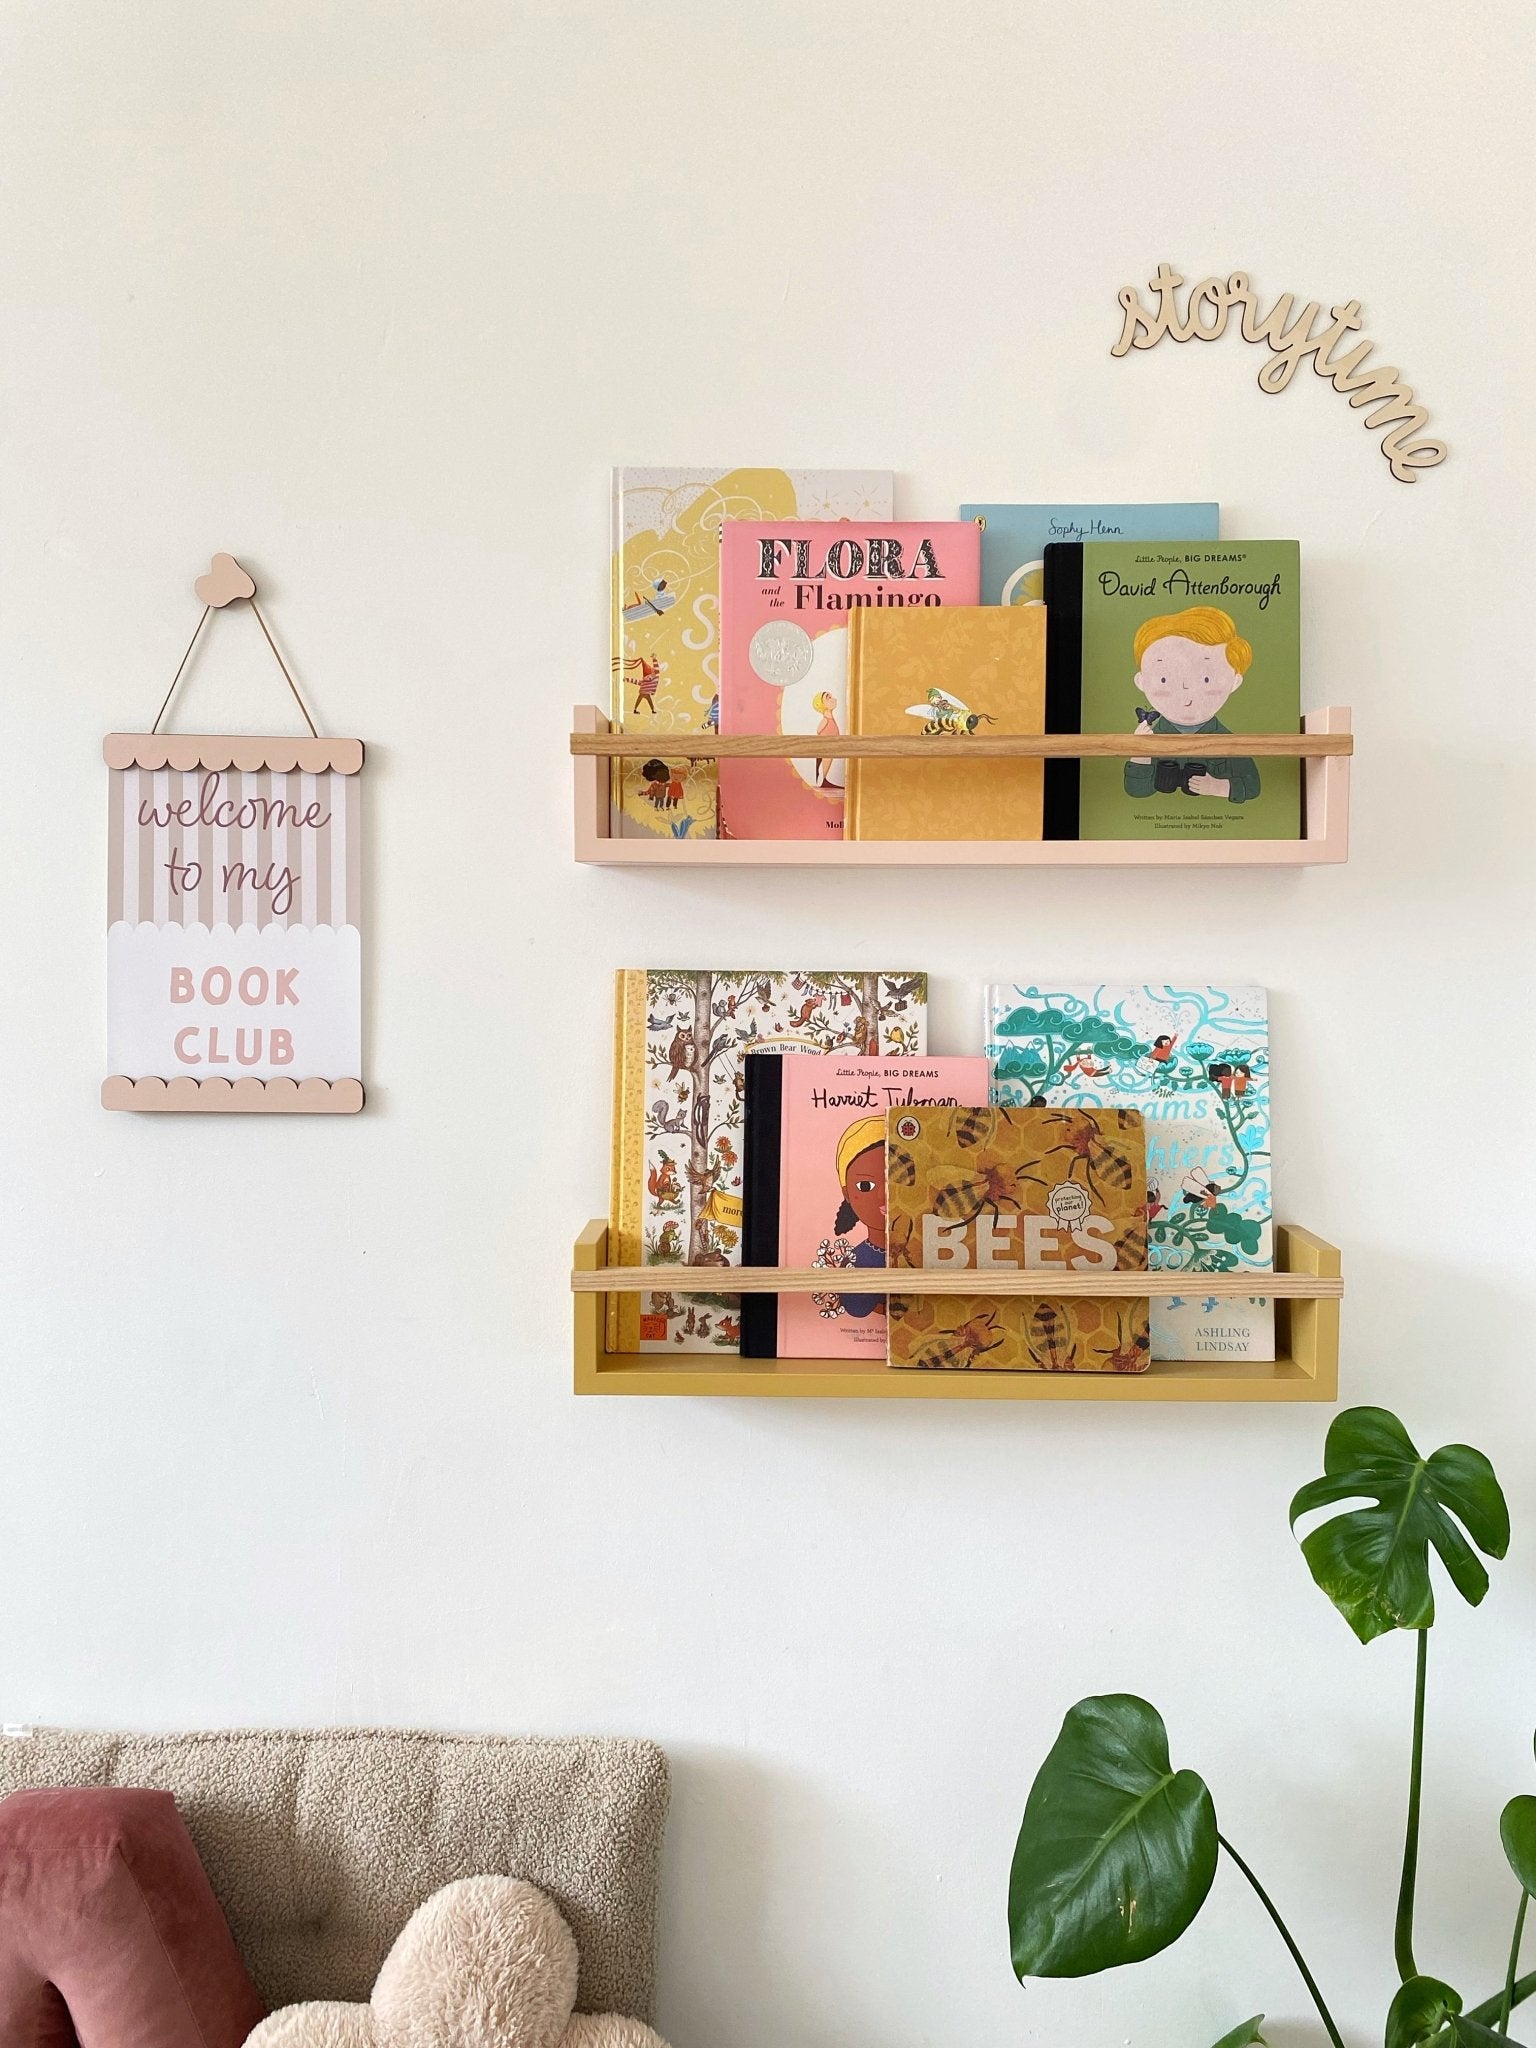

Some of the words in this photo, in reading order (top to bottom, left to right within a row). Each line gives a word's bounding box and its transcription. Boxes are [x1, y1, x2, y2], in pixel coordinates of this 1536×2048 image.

[1110, 263, 1448, 483] storytime
[1048, 517, 1089, 541] Sophy
[1090, 519, 1124, 535] Henn
[756, 538, 946, 581] FLORA
[1134, 554, 1155, 563] Little
[1184, 554, 1202, 562] BIG
[761, 586, 781, 595] and
[1098, 570, 1157, 596] David
[1162, 568, 1282, 611] Attenborough
[769, 598, 785, 608] the
[137, 771, 332, 830] welcome
[164, 847, 203, 896] to
[222, 862, 301, 915] my
[169, 965, 301, 1006] BOOK
[173, 1026, 295, 1066] CLUB
[751, 1045, 777, 1054] Brown
[780, 1043, 797, 1052] Bear
[800, 1044, 822, 1055] Wood
[836, 1068, 856, 1076] Little
[884, 1069, 900, 1077] BIG
[902, 1070, 939, 1078] DREAMS
[811, 1086, 878, 1108] Harriet
[1056, 1201, 1084, 1216] planet!
[922, 1214, 1118, 1271] BEES
[1195, 1328, 1250, 1337] ASHLING
[1196, 1342, 1249, 1351] LINDSAY
